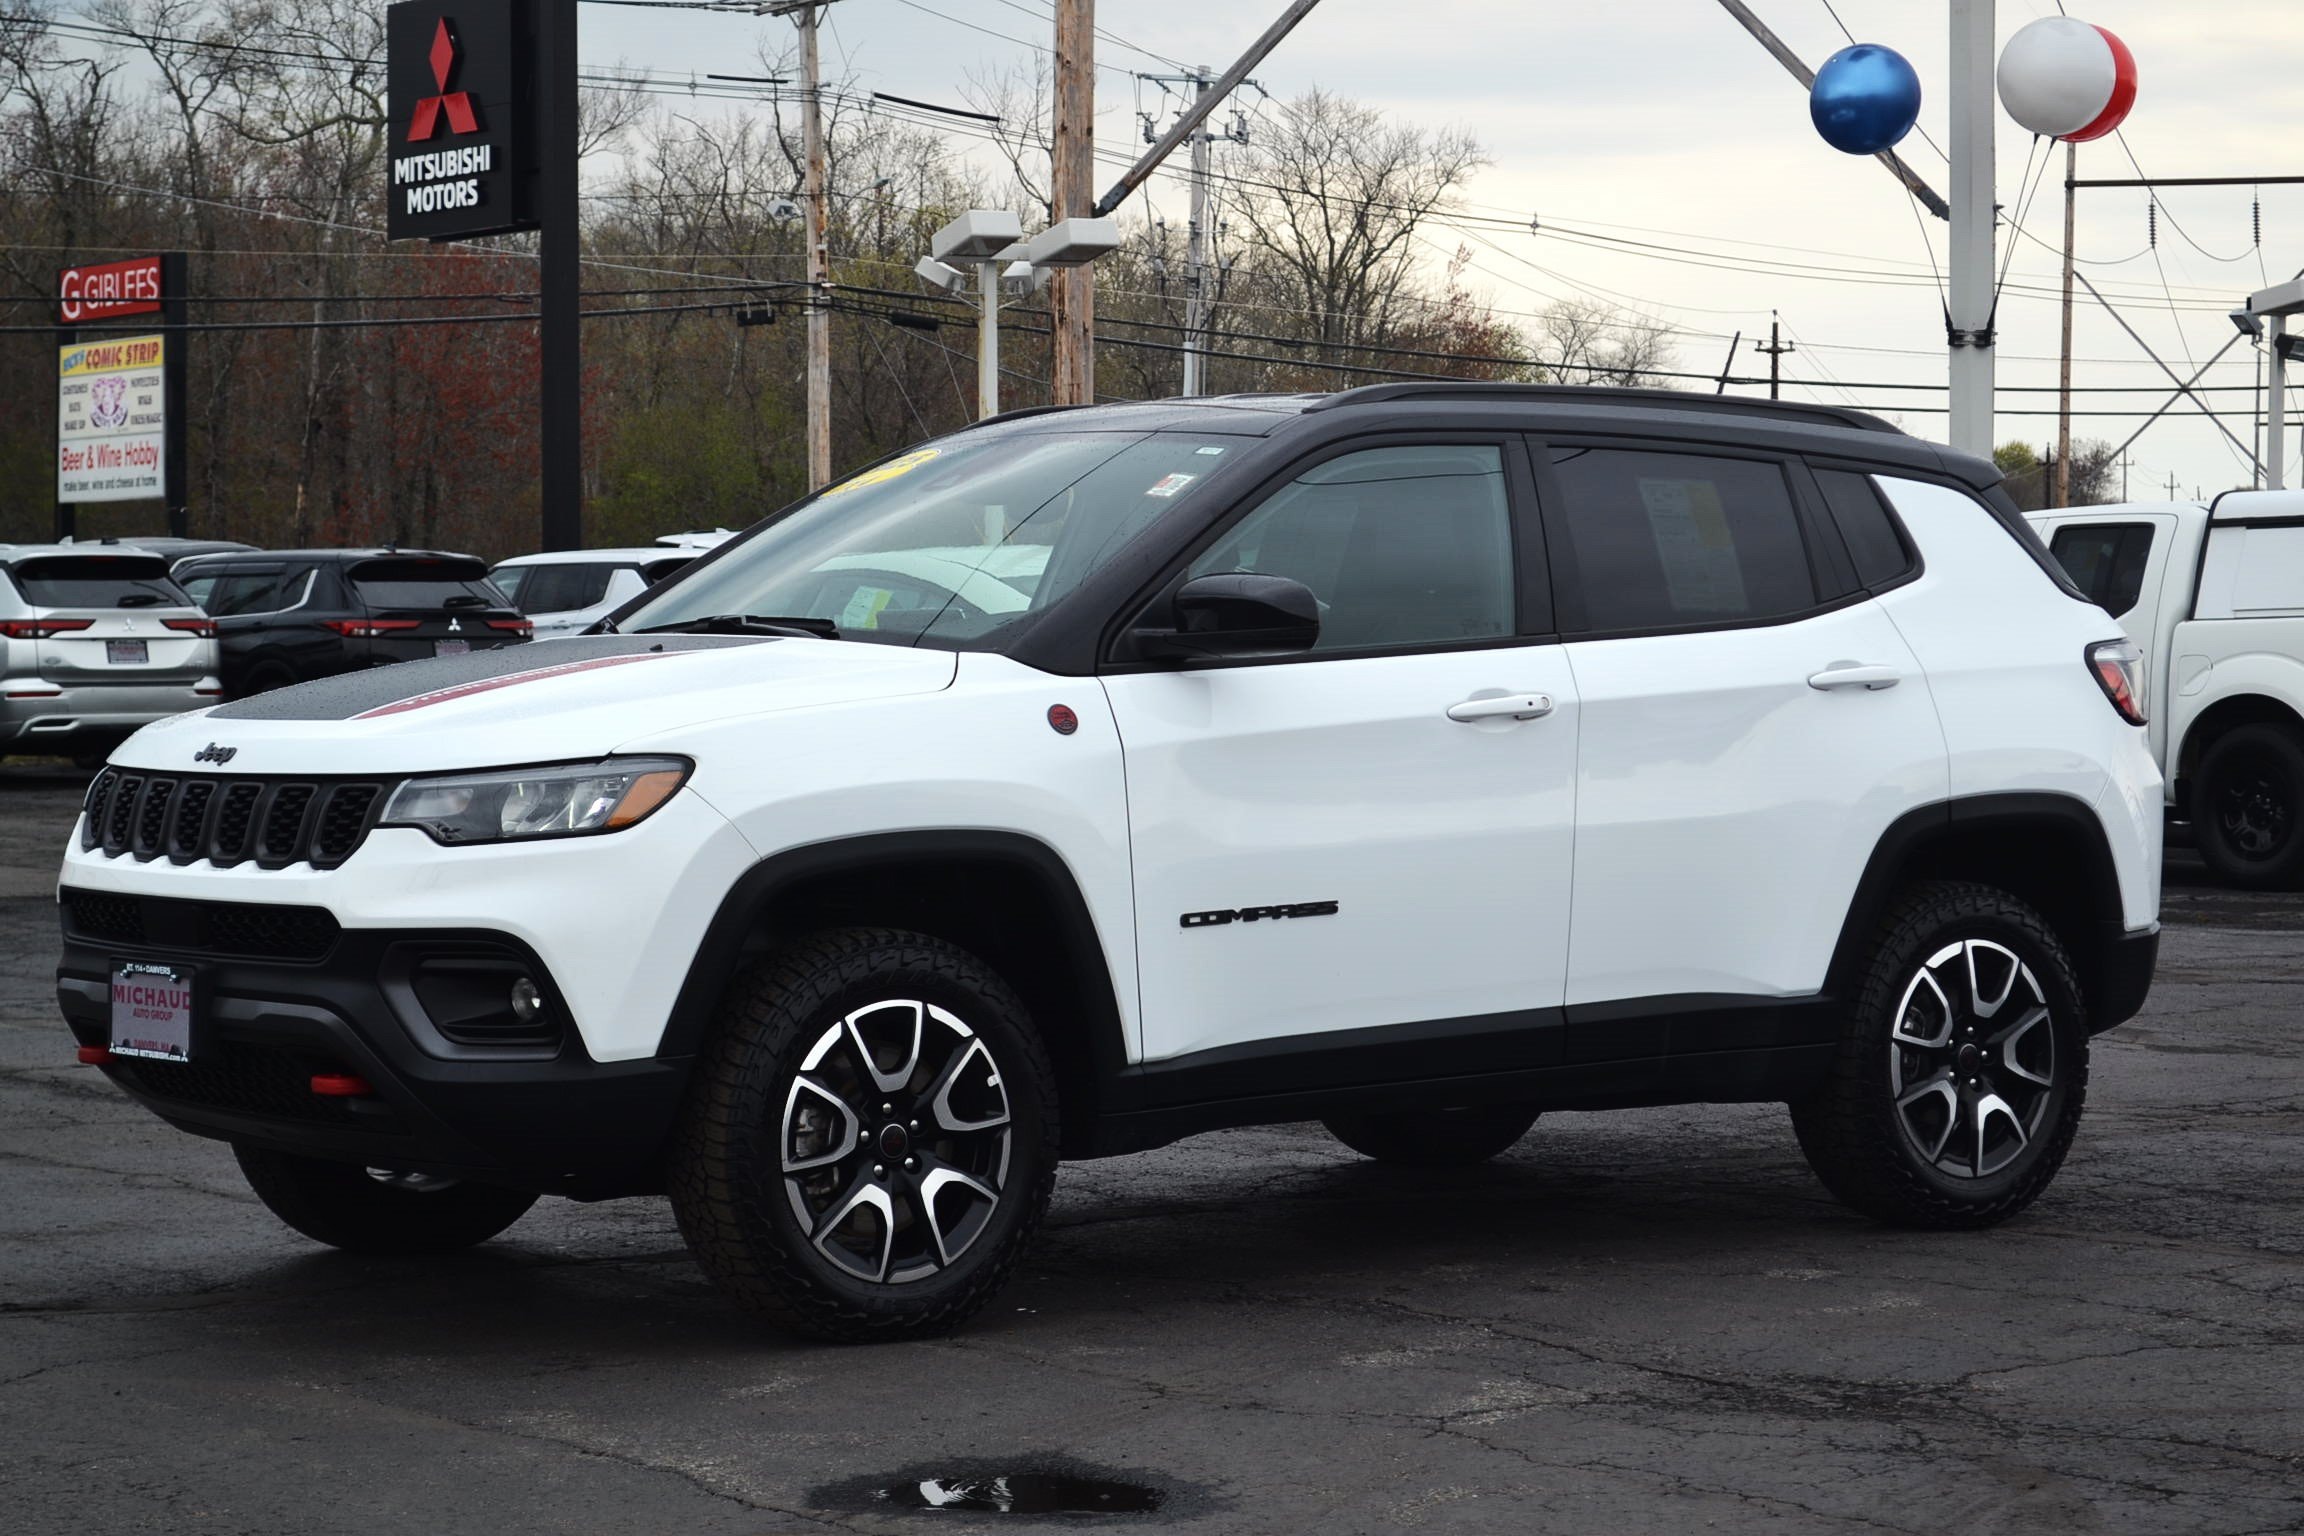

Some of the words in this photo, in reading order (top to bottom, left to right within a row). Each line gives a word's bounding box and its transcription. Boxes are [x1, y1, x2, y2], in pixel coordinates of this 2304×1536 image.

[394, 144, 491, 185] MITSUBISHI
[407, 178, 479, 215] MOTORS
[61, 270, 80, 319] G
[86, 346, 123, 369] COMIC
[125, 341, 159, 366] STRIP
[62, 446, 84, 472] Beer
[87, 444, 94, 470] &
[97, 443, 121, 469] Wine
[125, 440, 159, 472] Hobby
[194, 742, 238, 767] Jeep
[1180, 899, 1340, 929] COMPASS
[113, 984, 192, 1011] MICHAUD
[133, 1008, 149, 1018] AUTO
[151, 1010, 173, 1020] GROUP
